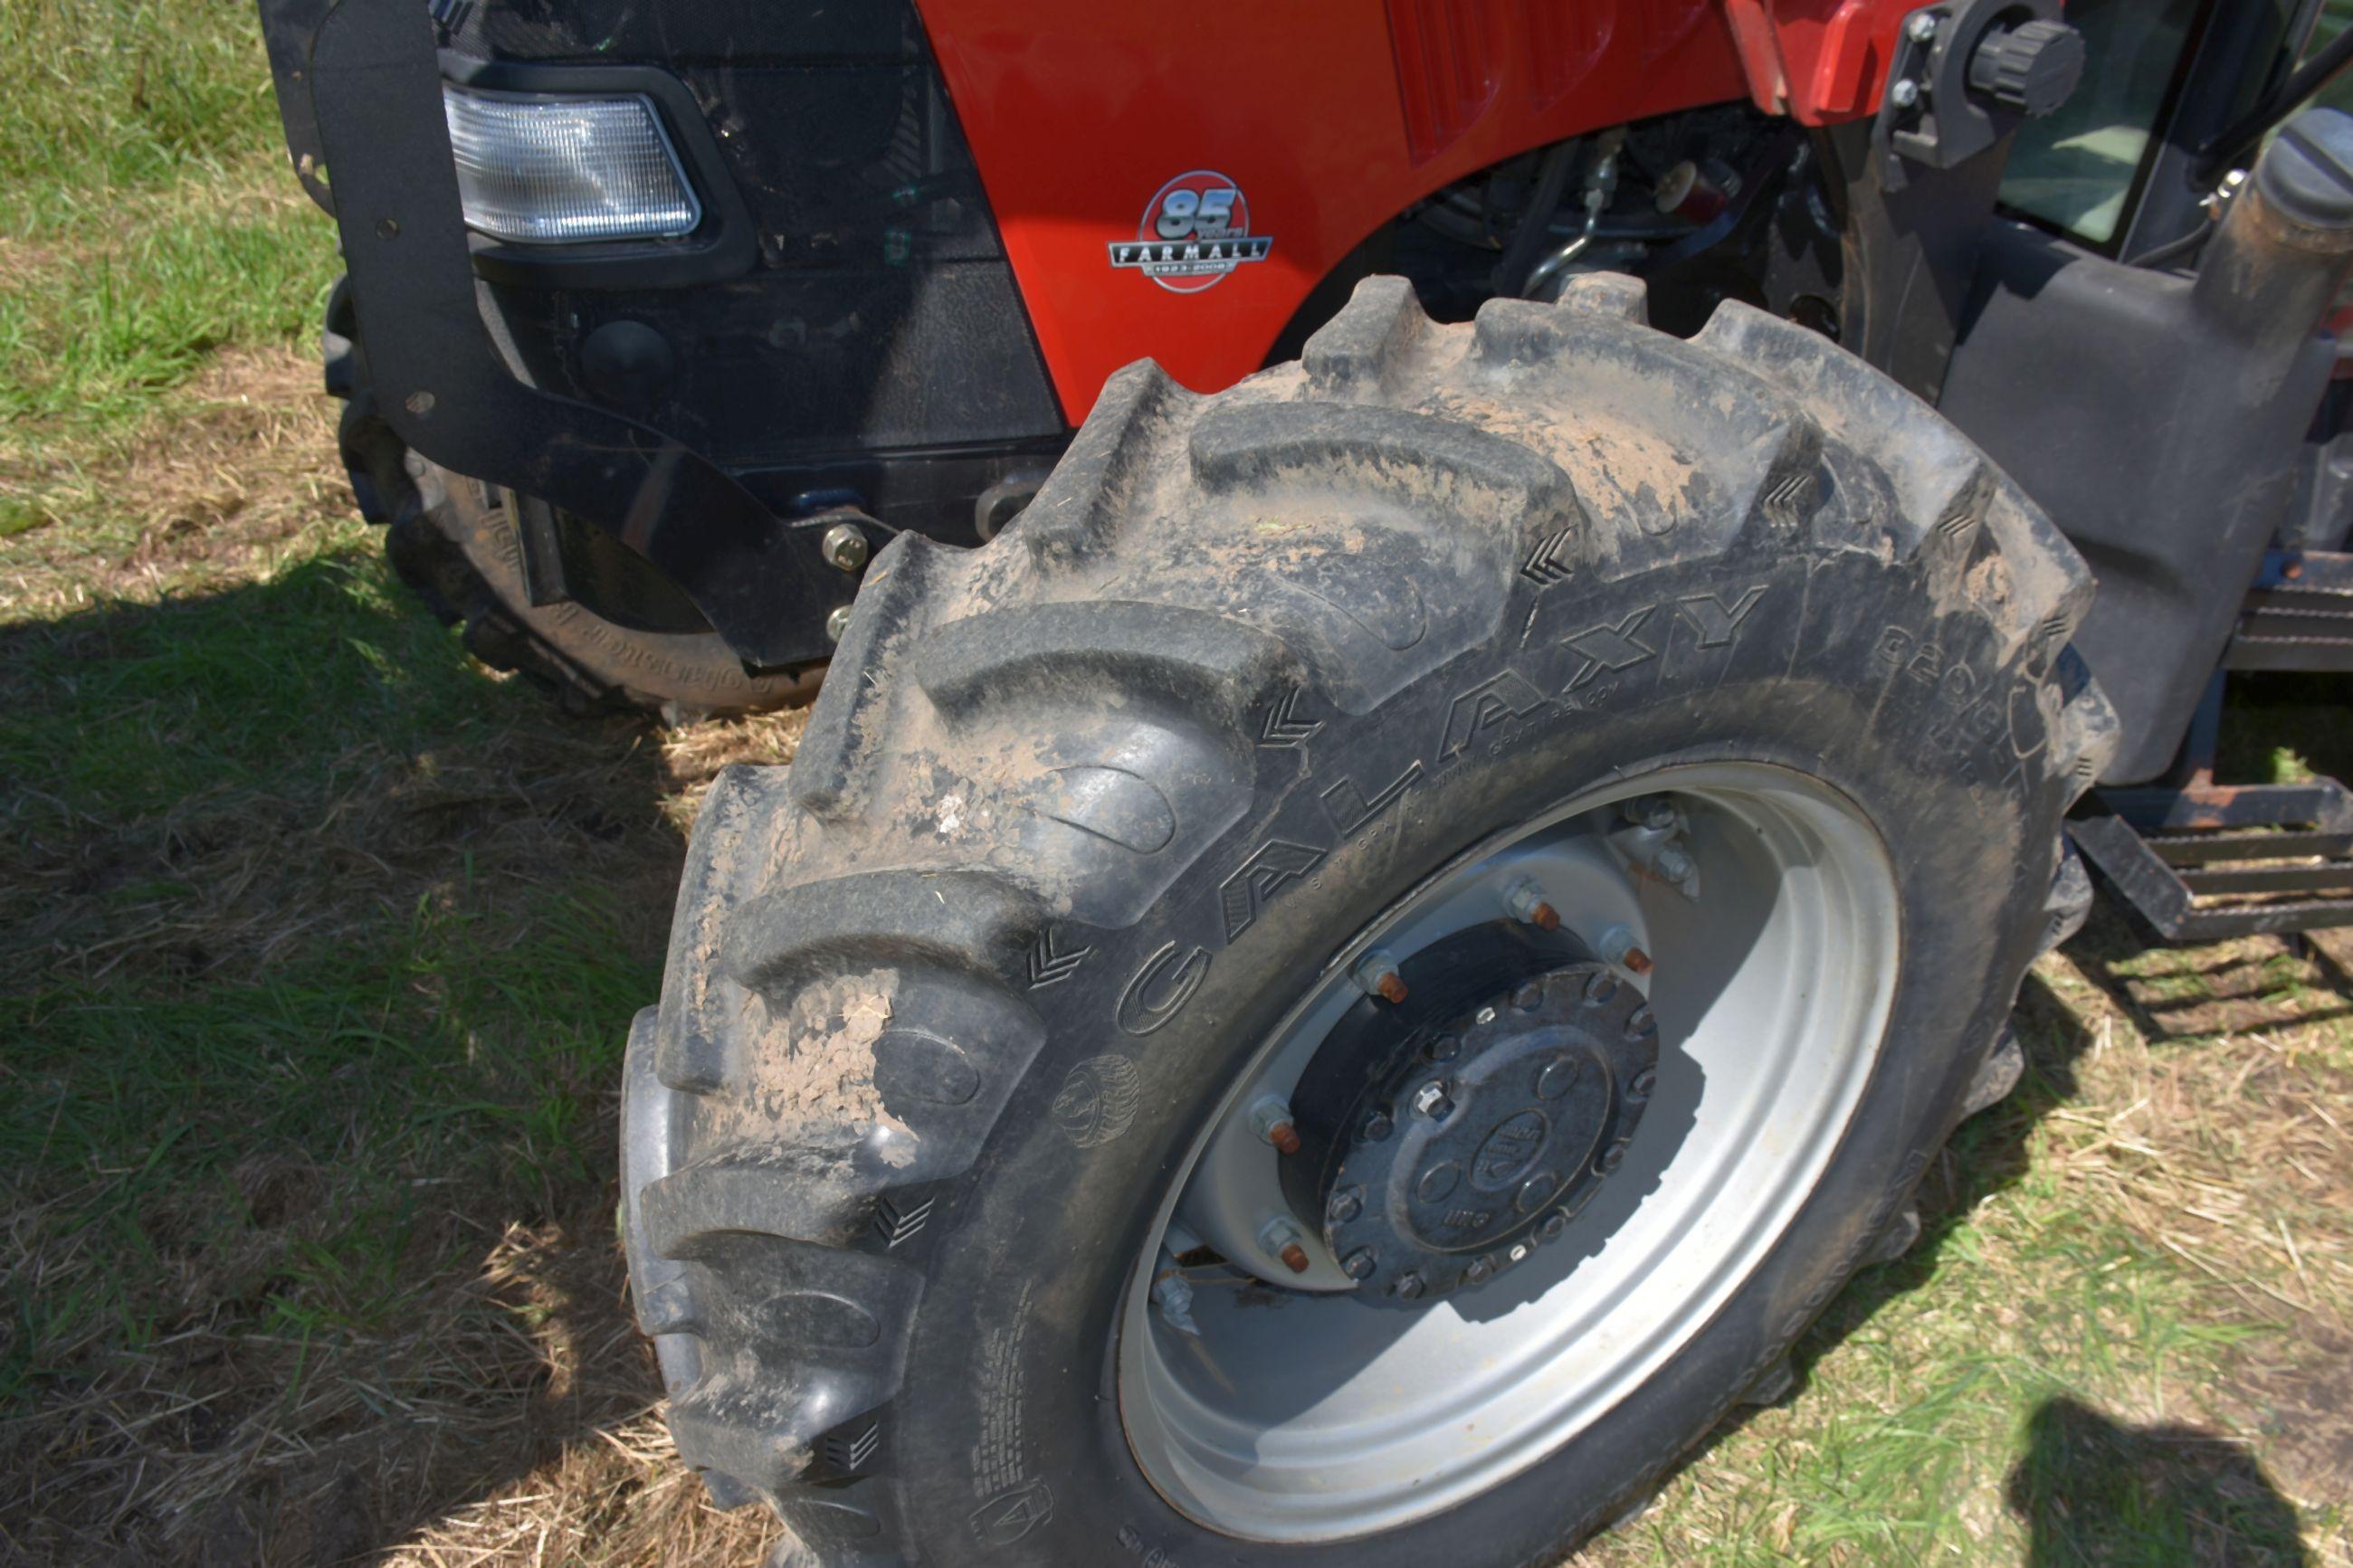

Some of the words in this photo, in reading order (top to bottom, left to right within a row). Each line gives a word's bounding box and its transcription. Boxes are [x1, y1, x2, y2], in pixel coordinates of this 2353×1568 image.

[1157, 188, 1237, 239] 85
[1119, 242, 1261, 262] FARMALL
[1115, 584, 1770, 1037] GALAXY
